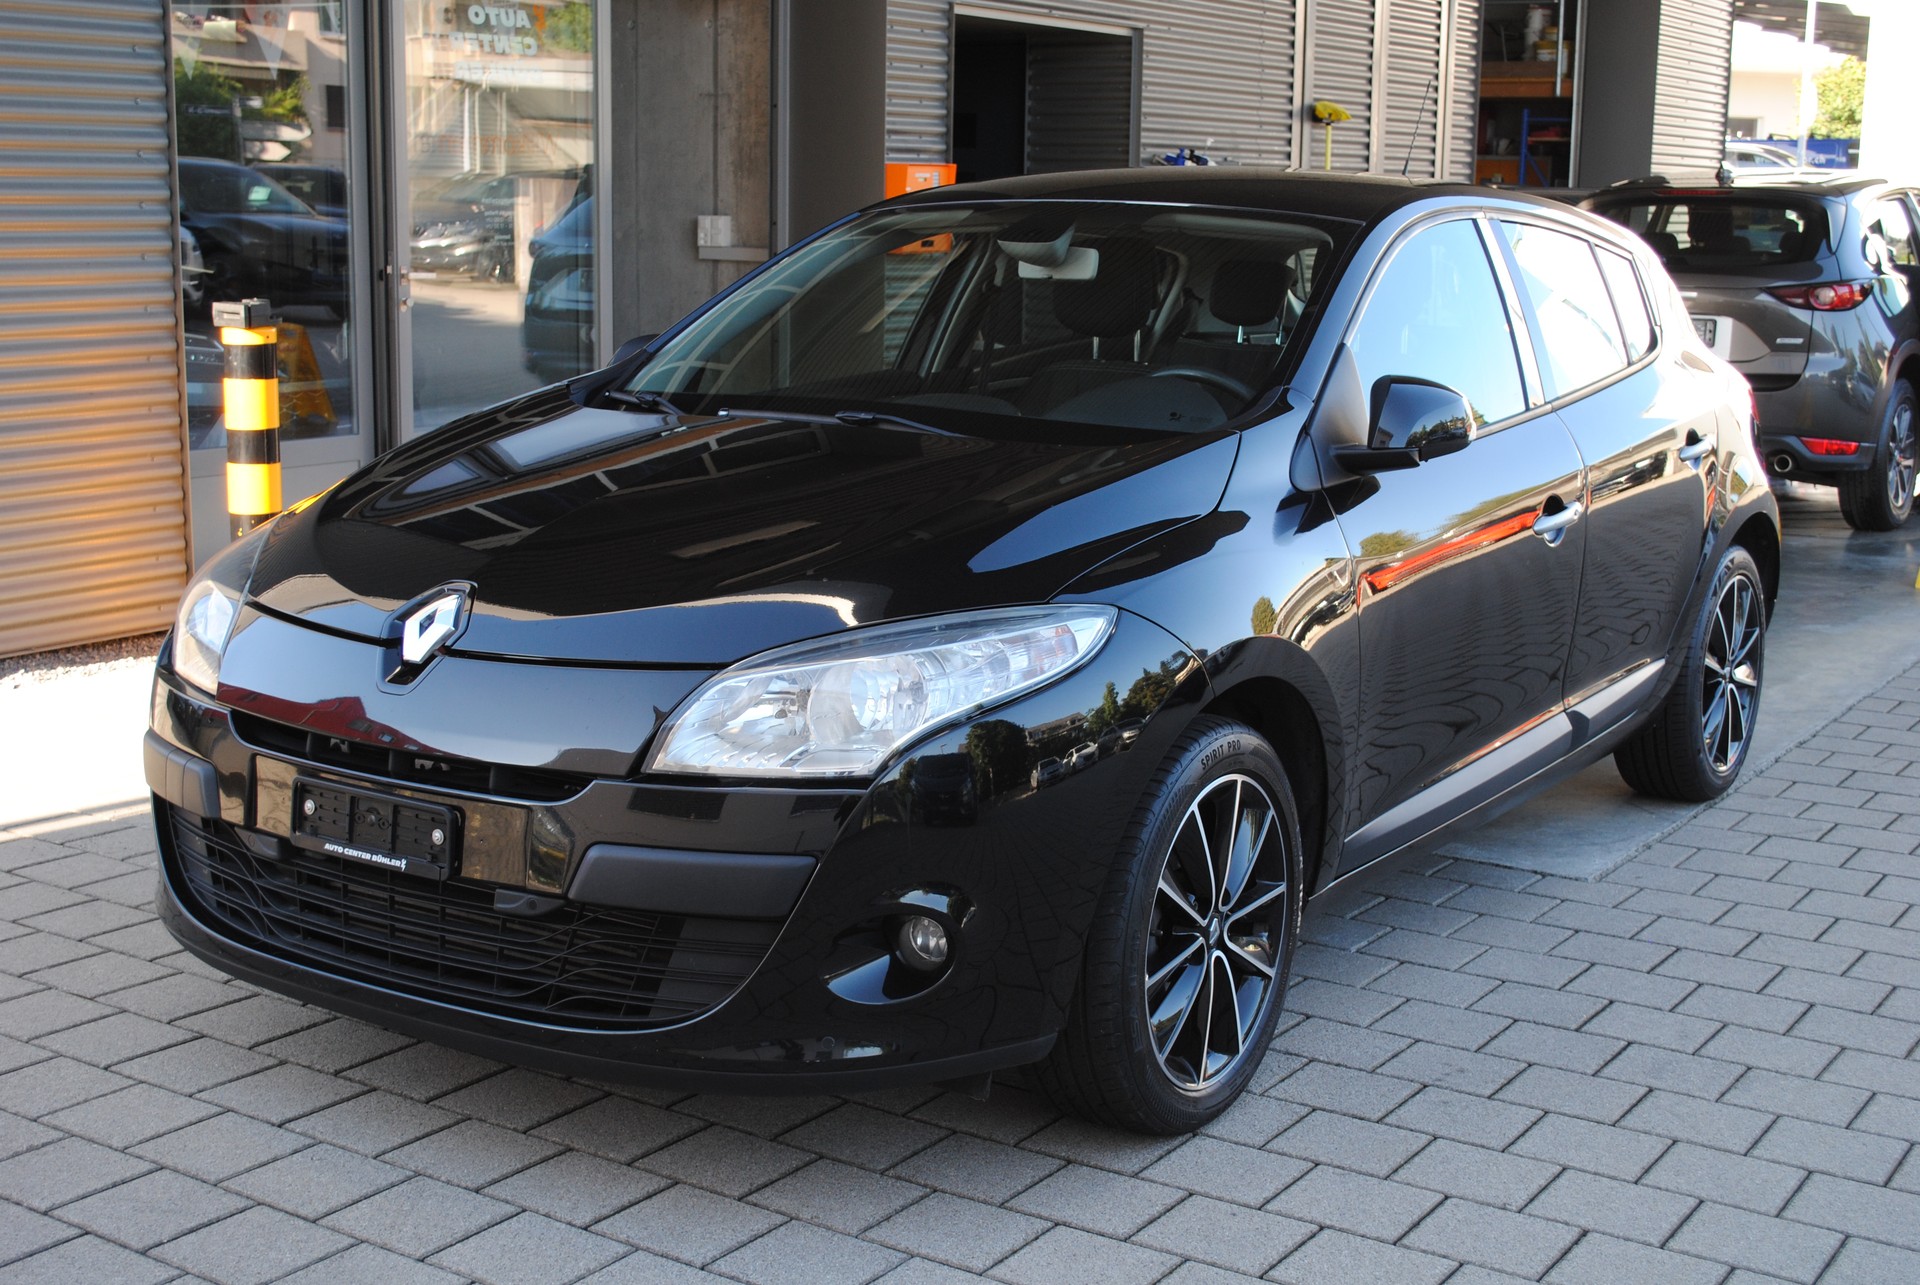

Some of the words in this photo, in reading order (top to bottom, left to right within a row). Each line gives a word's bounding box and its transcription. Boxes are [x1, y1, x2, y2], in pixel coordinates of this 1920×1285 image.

[1201, 744, 1224, 770] SPIRIT
[1228, 740, 1241, 752] PRO
[324, 843, 343, 854] AUTO
[344, 847, 371, 860] CENTER
[372, 854, 401, 867] BÜHLER
